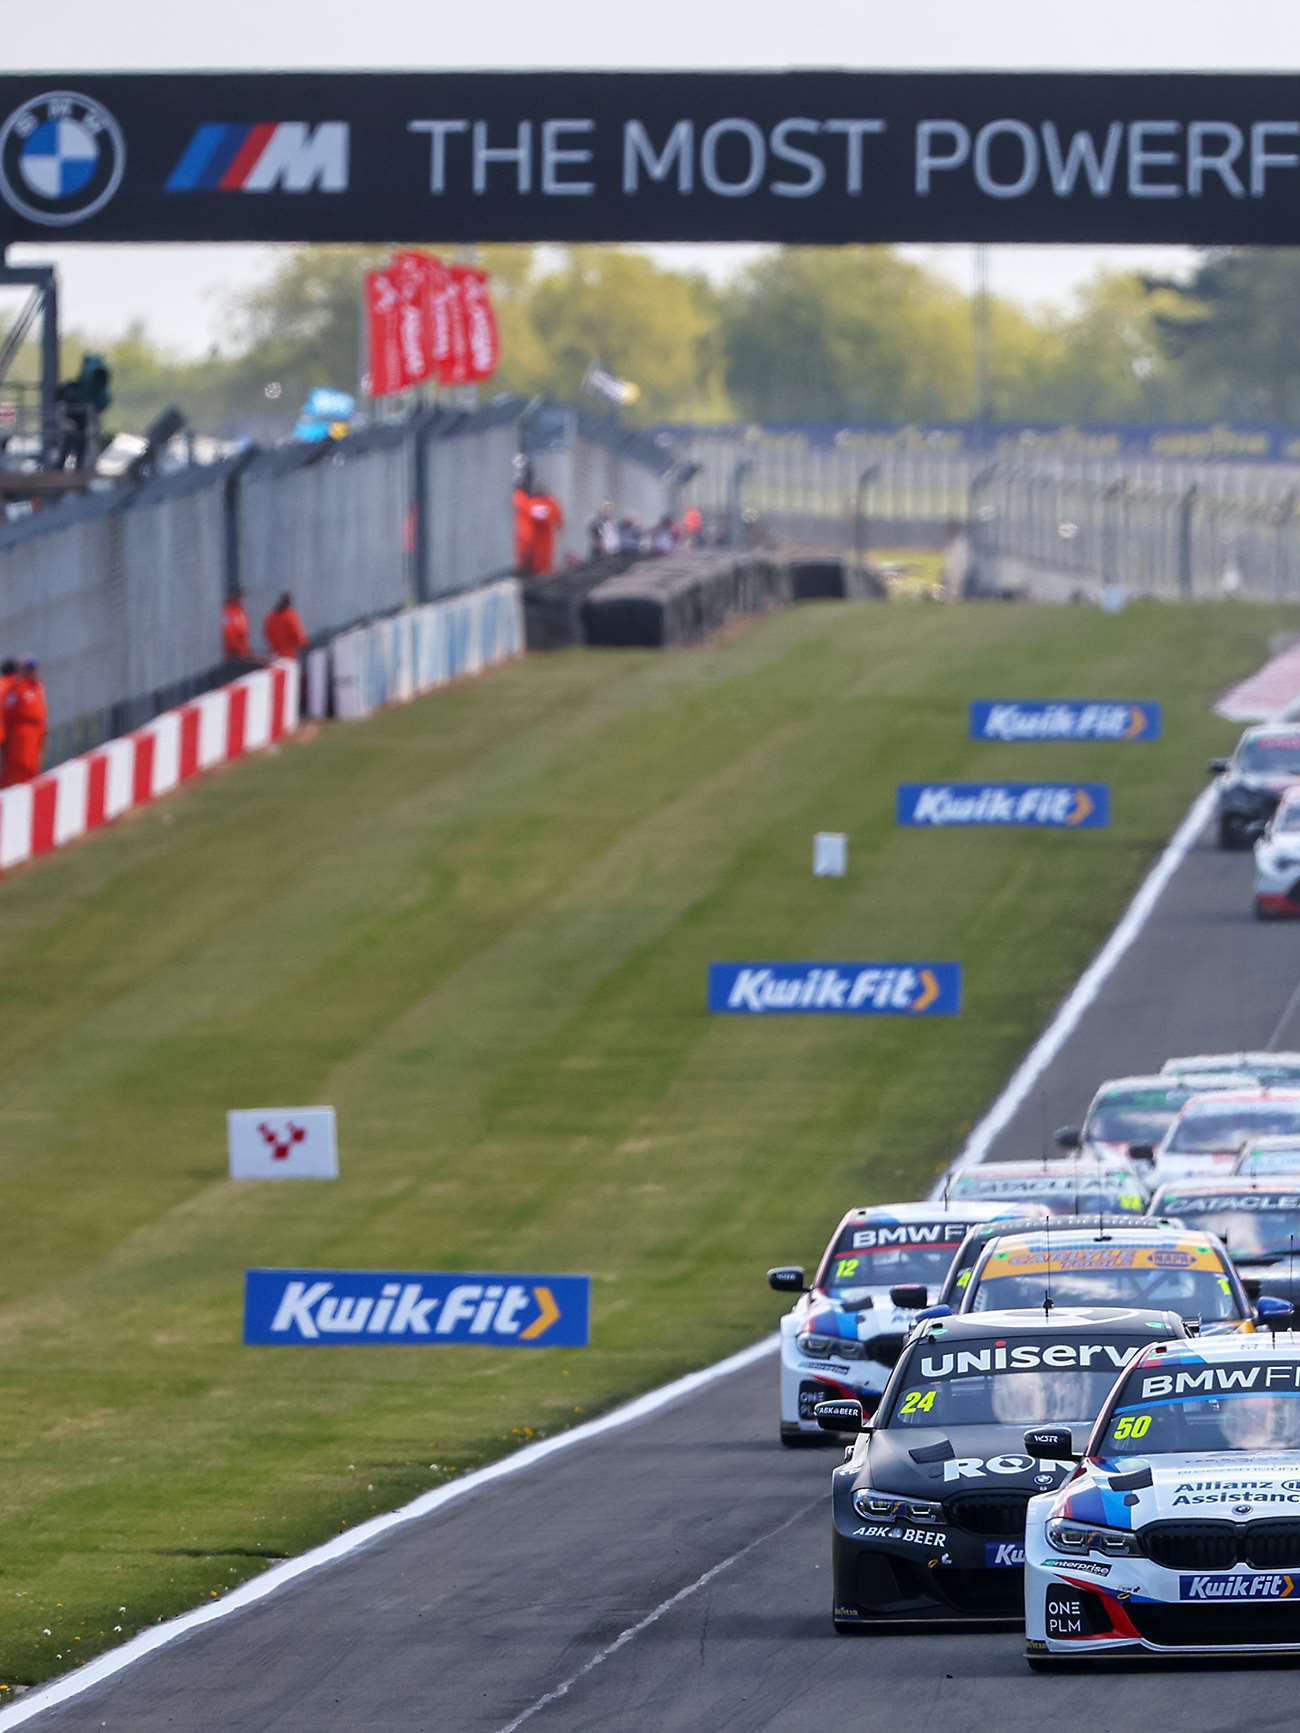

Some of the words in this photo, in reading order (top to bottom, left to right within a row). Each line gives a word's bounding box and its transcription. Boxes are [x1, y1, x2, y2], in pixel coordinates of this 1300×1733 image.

[408, 118, 595, 196] THE
[623, 118, 884, 197] MOST
[836, 1258, 860, 1278] 12
[900, 1390, 938, 1414] 24
[1113, 1415, 1153, 1440] 50
[1033, 1435, 1059, 1443] WSR
[1174, 1481, 1274, 1494] Allianz
[852, 1526, 890, 1537] ABK
[902, 1528, 947, 1548] BEER
[1048, 1601, 1080, 1615] ONE
[1049, 1619, 1081, 1632] PLM
